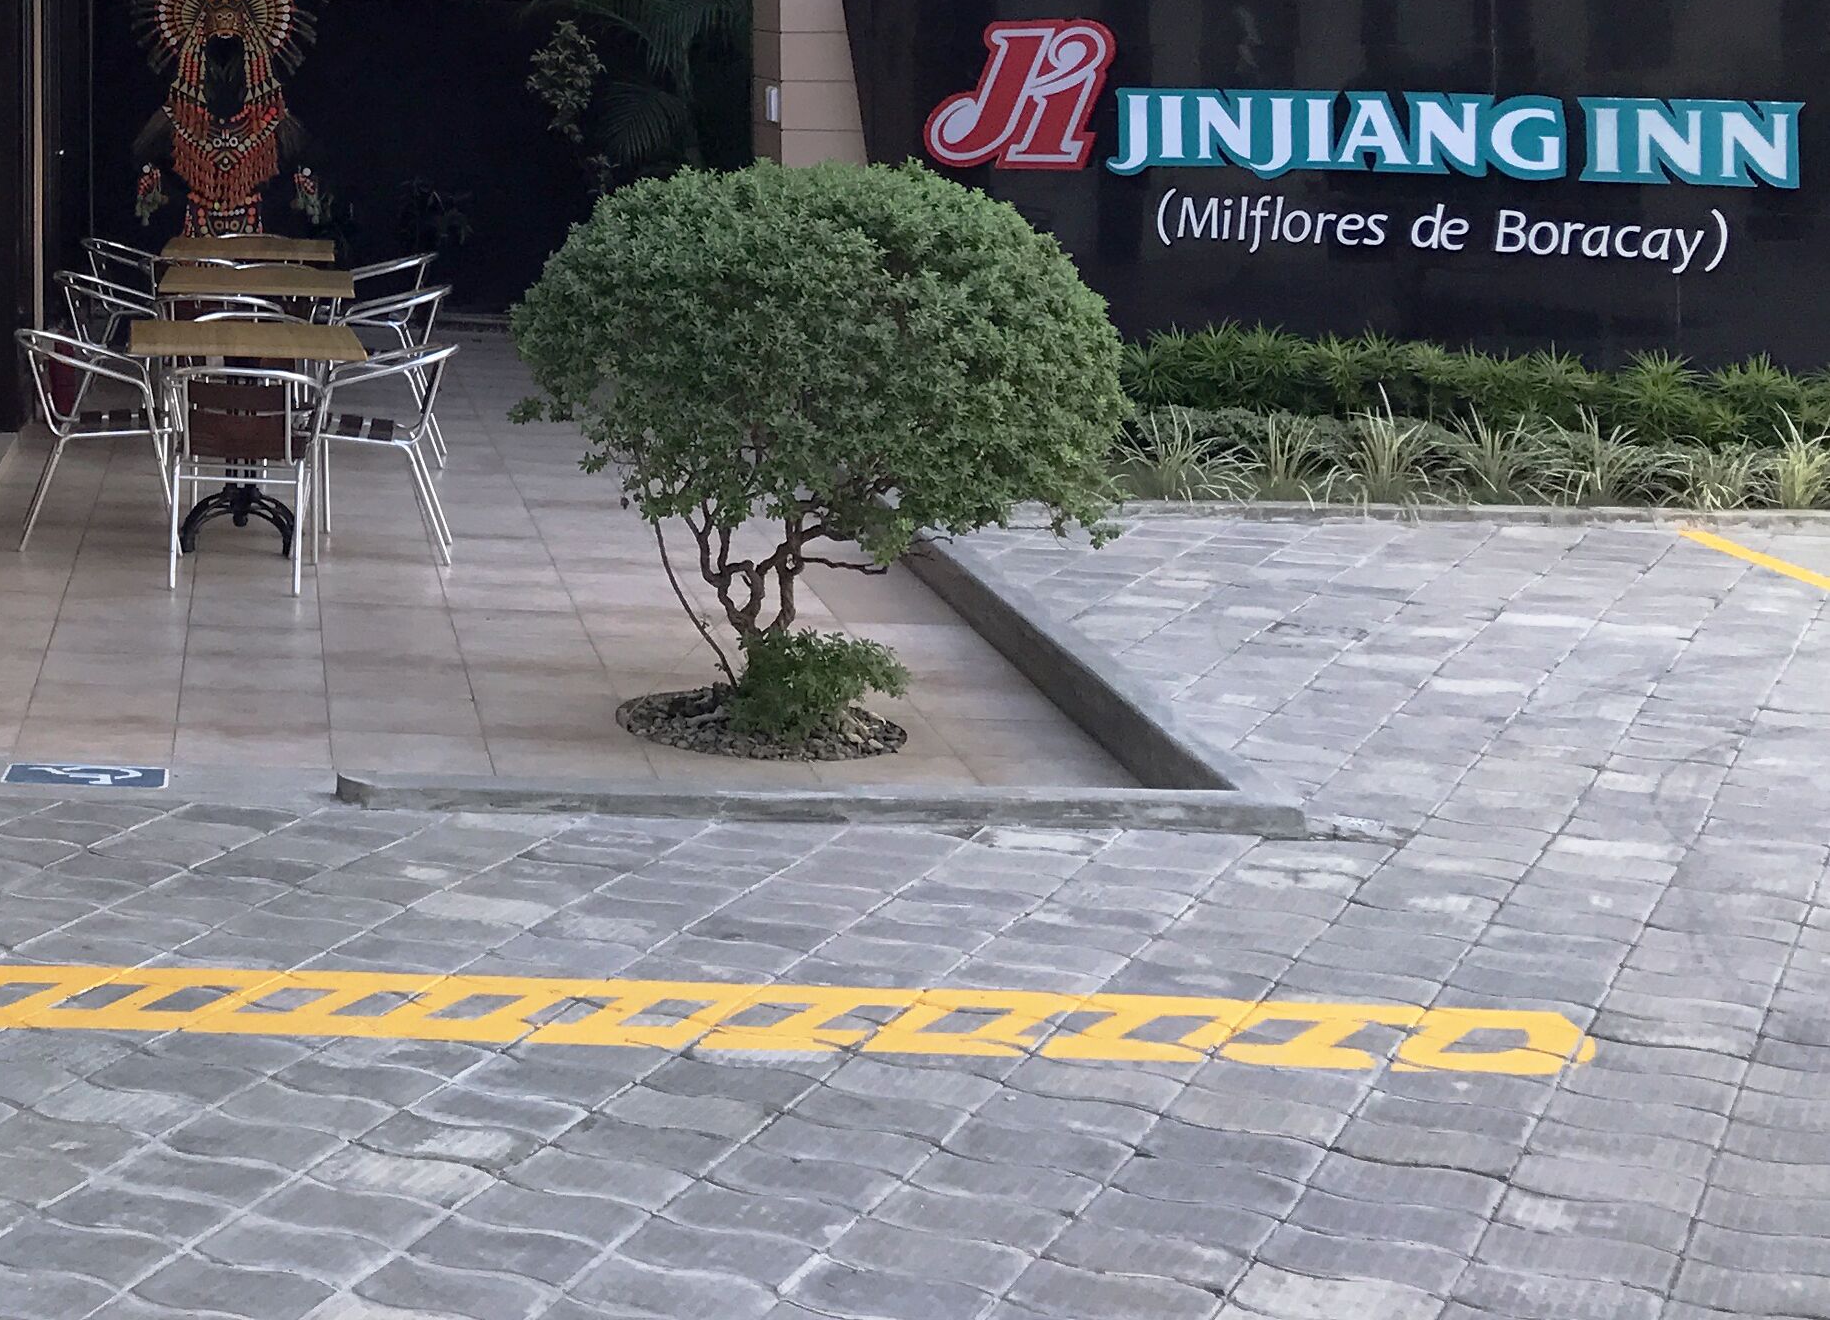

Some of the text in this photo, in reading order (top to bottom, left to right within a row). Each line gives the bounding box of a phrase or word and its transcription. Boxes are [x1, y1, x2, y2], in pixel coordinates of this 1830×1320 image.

[1107, 91, 1798, 185] JINJIANG INN
[1156, 187, 1729, 274] (Milflores de Boracay)
